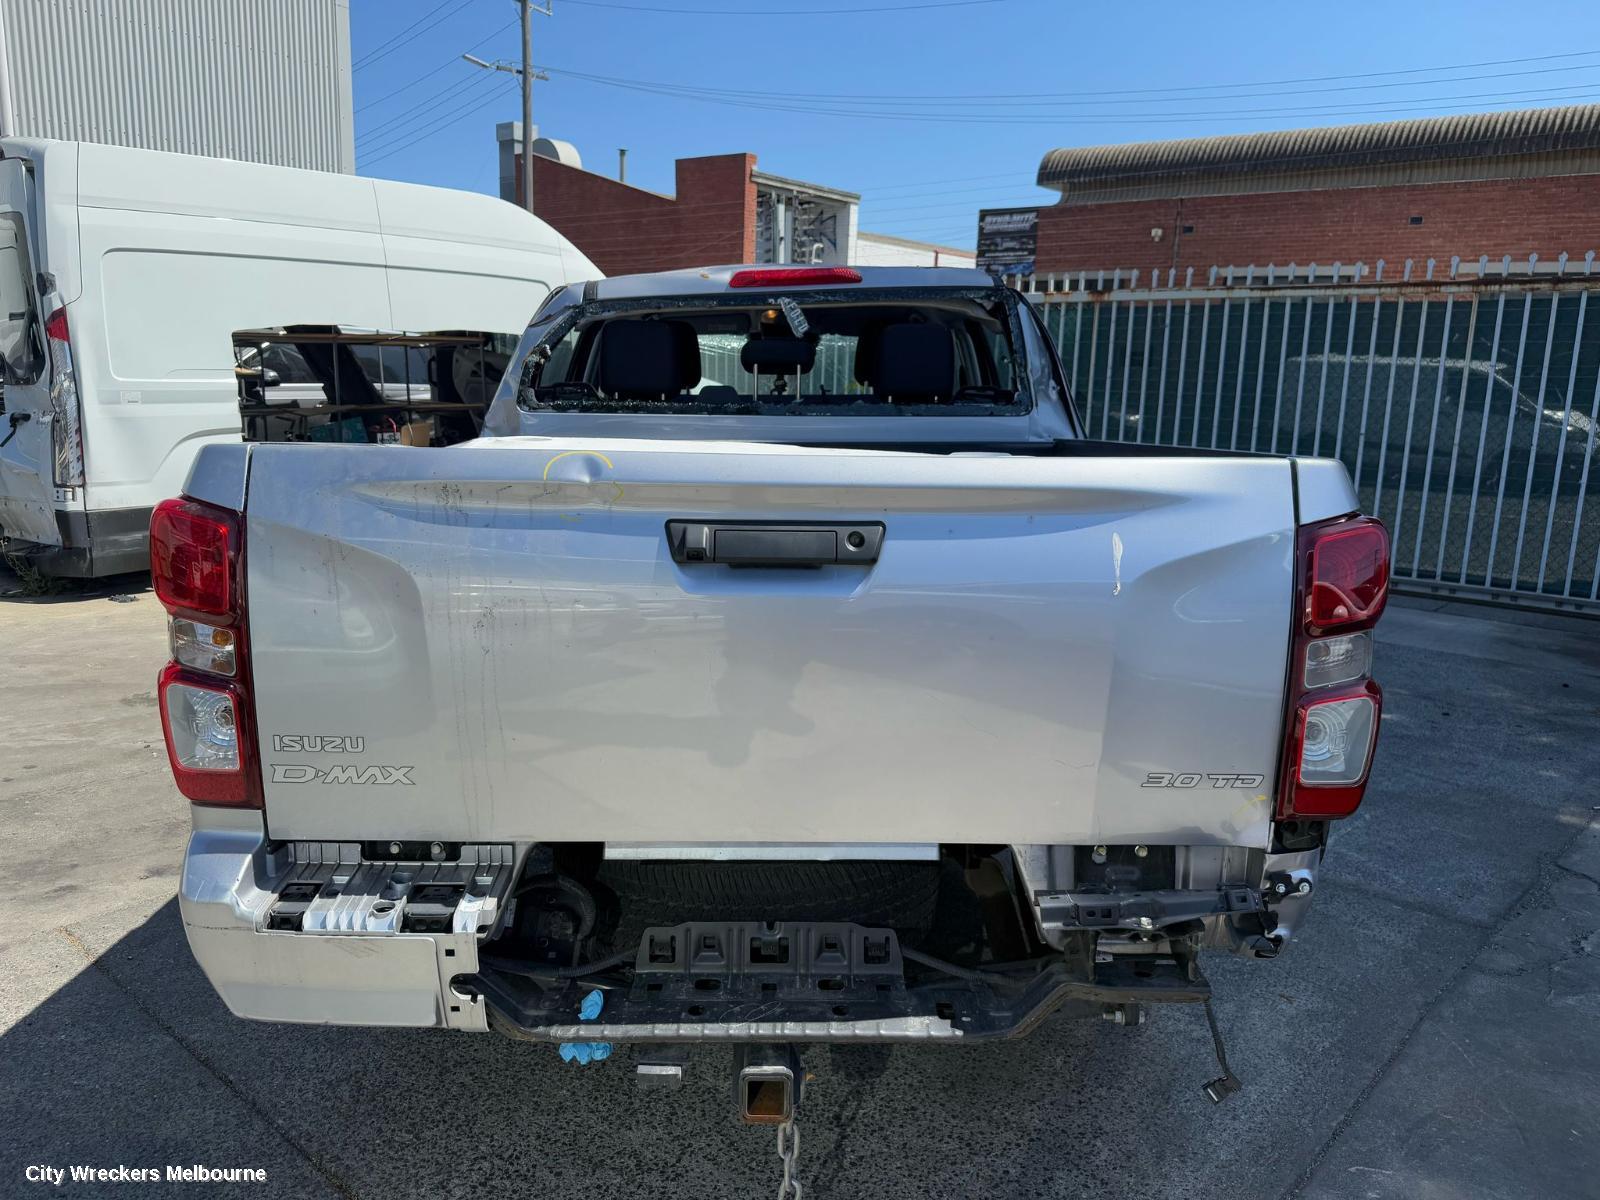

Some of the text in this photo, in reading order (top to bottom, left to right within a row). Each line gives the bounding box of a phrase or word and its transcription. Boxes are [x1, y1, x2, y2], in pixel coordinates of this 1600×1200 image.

[272, 734, 365, 753] ISUZU
[270, 763, 416, 786] D-MAX
[1141, 772, 1265, 789] 3.0 TD
